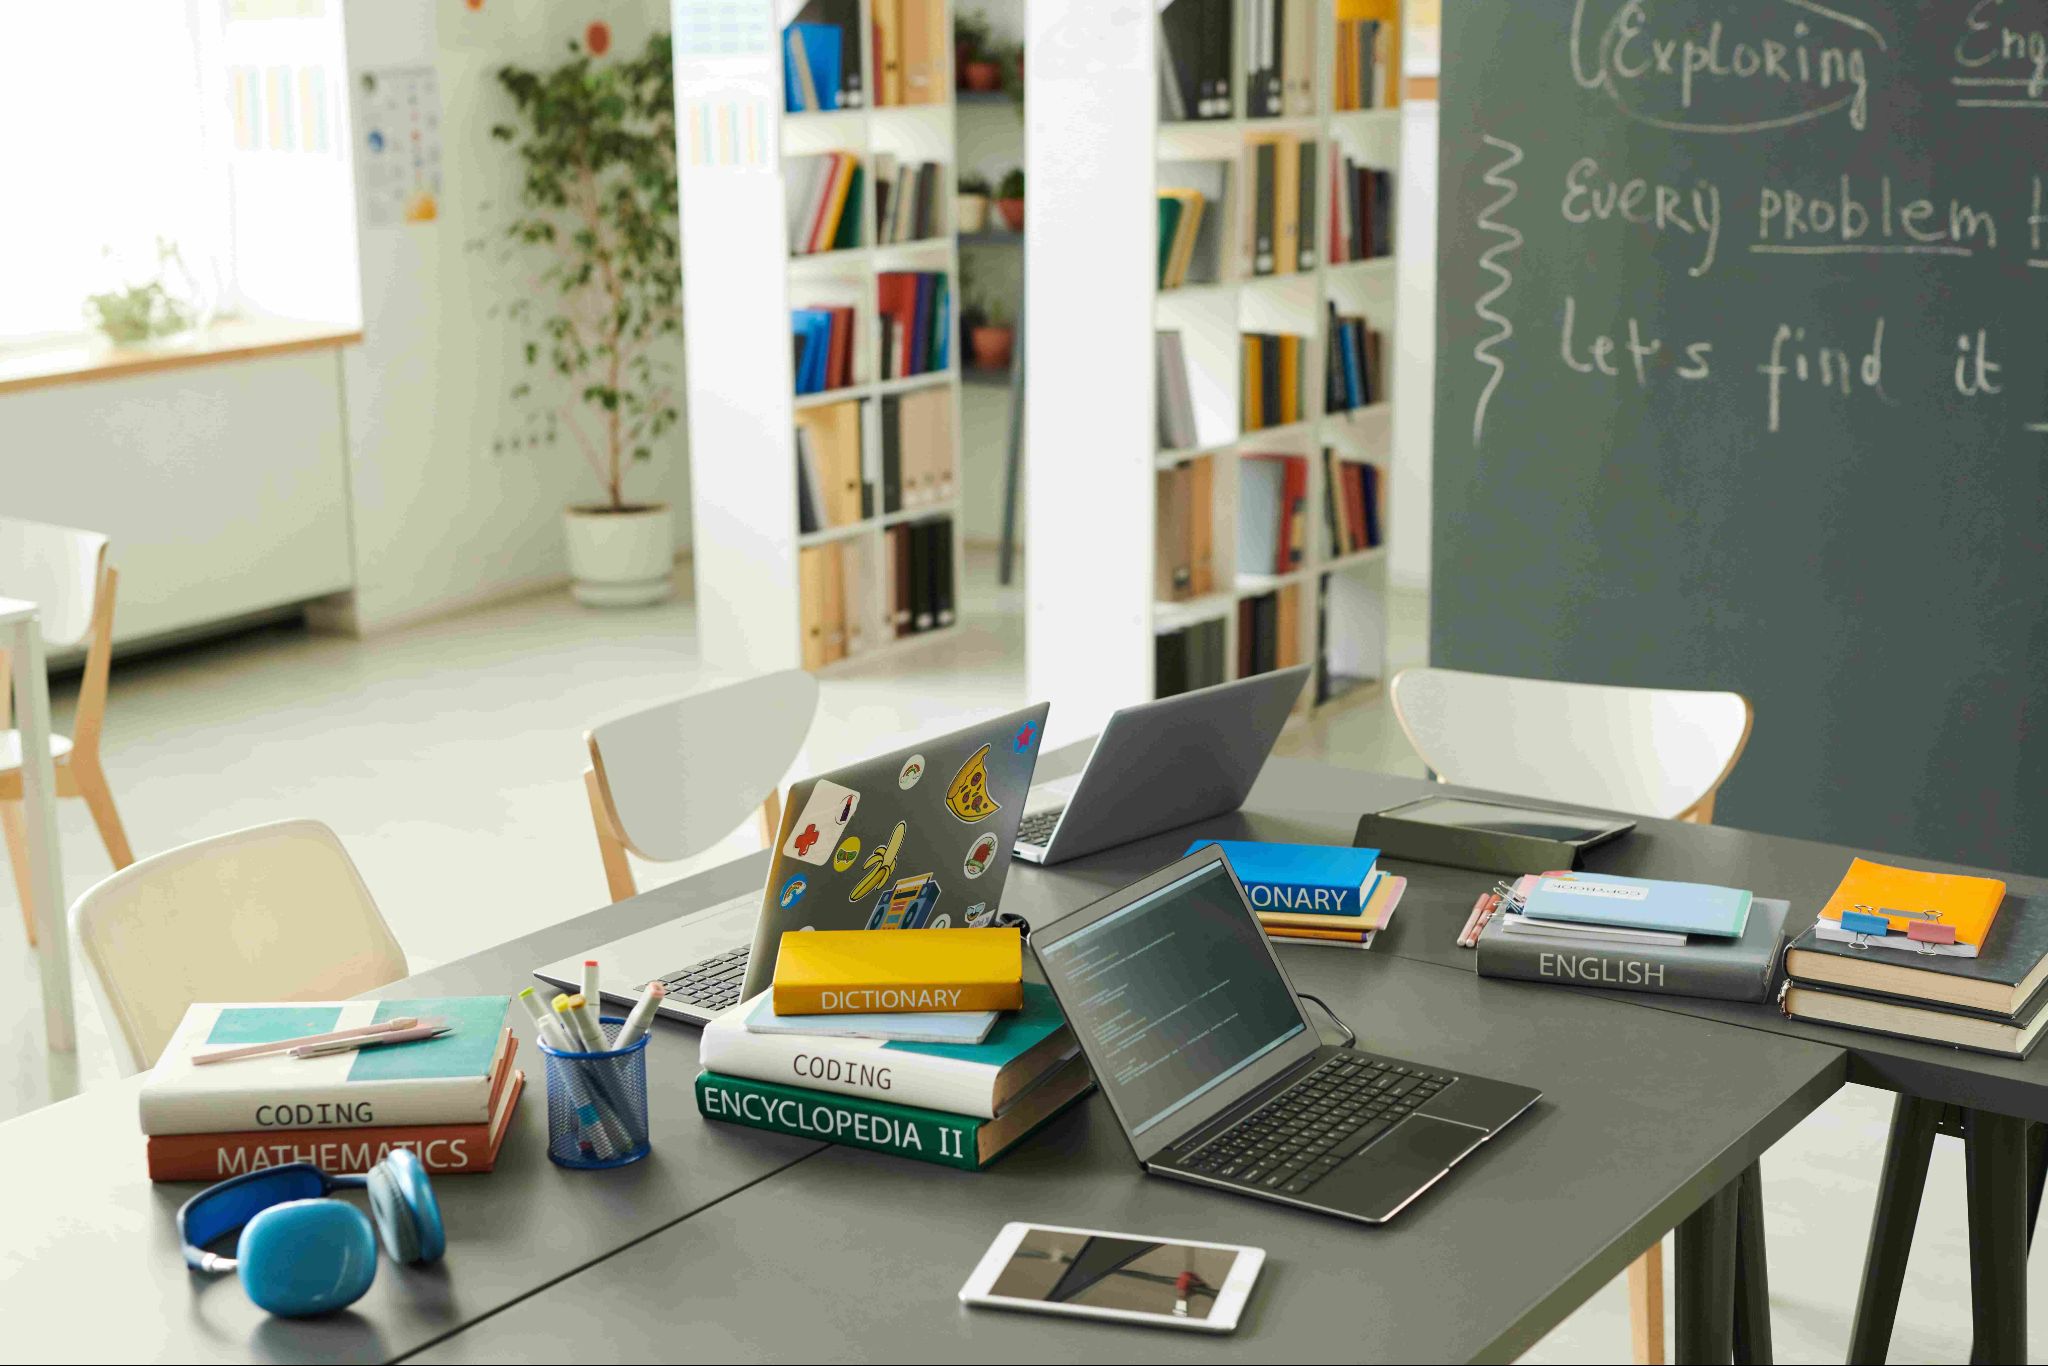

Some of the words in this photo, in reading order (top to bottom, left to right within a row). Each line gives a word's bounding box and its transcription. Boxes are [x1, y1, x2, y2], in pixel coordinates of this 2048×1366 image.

[1758, 317, 1886, 433] find
[1955, 328, 2004, 396] it
[1538, 953, 1665, 987] ENGLISH
[821, 989, 962, 1010] DICTIONARY
[792, 1054, 892, 1090] CODING
[255, 1102, 374, 1127] CODING
[704, 1087, 922, 1151] ENCYCLOPEDIA
[938, 1126, 963, 1159] II
